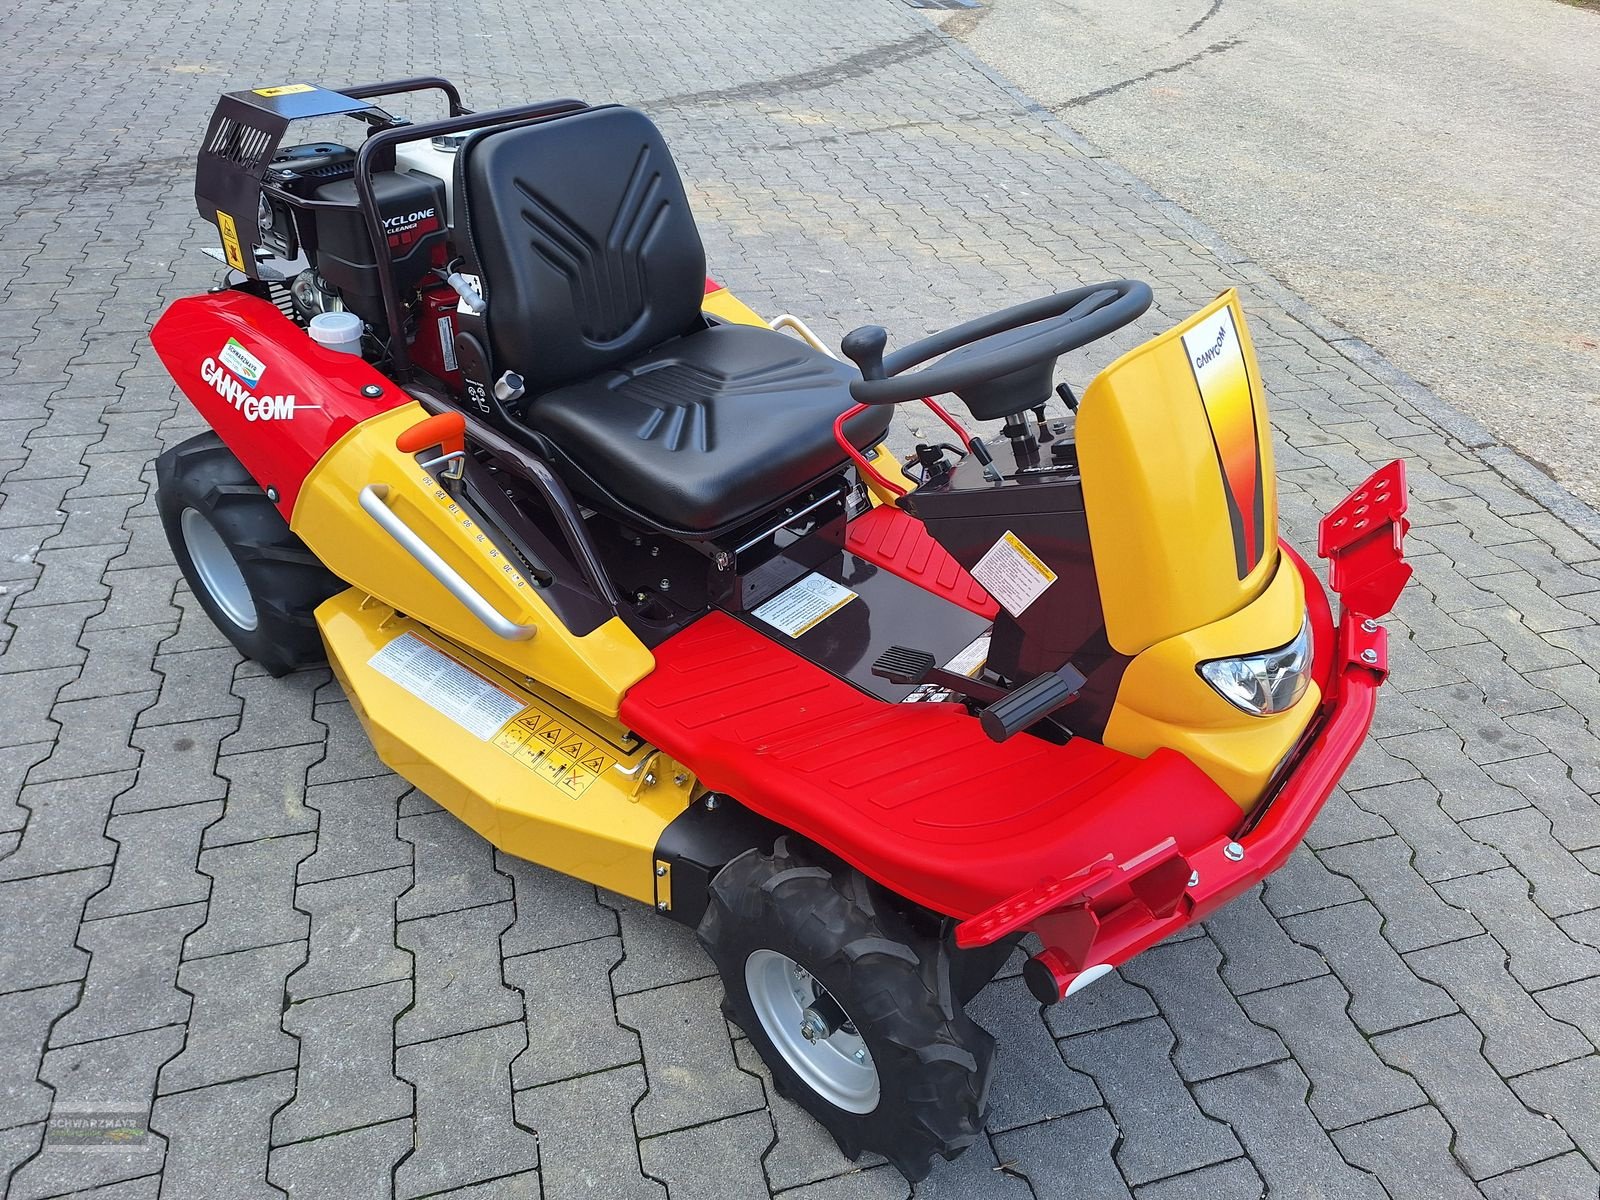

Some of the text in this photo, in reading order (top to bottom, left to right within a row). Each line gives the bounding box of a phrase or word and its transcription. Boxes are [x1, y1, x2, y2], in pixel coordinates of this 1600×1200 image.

[382, 208, 434, 228] YCLONE
[387, 222, 417, 234] CLEANER
[1196, 326, 1226, 368] CANYCOM
[201, 357, 296, 421] CANYCOM
